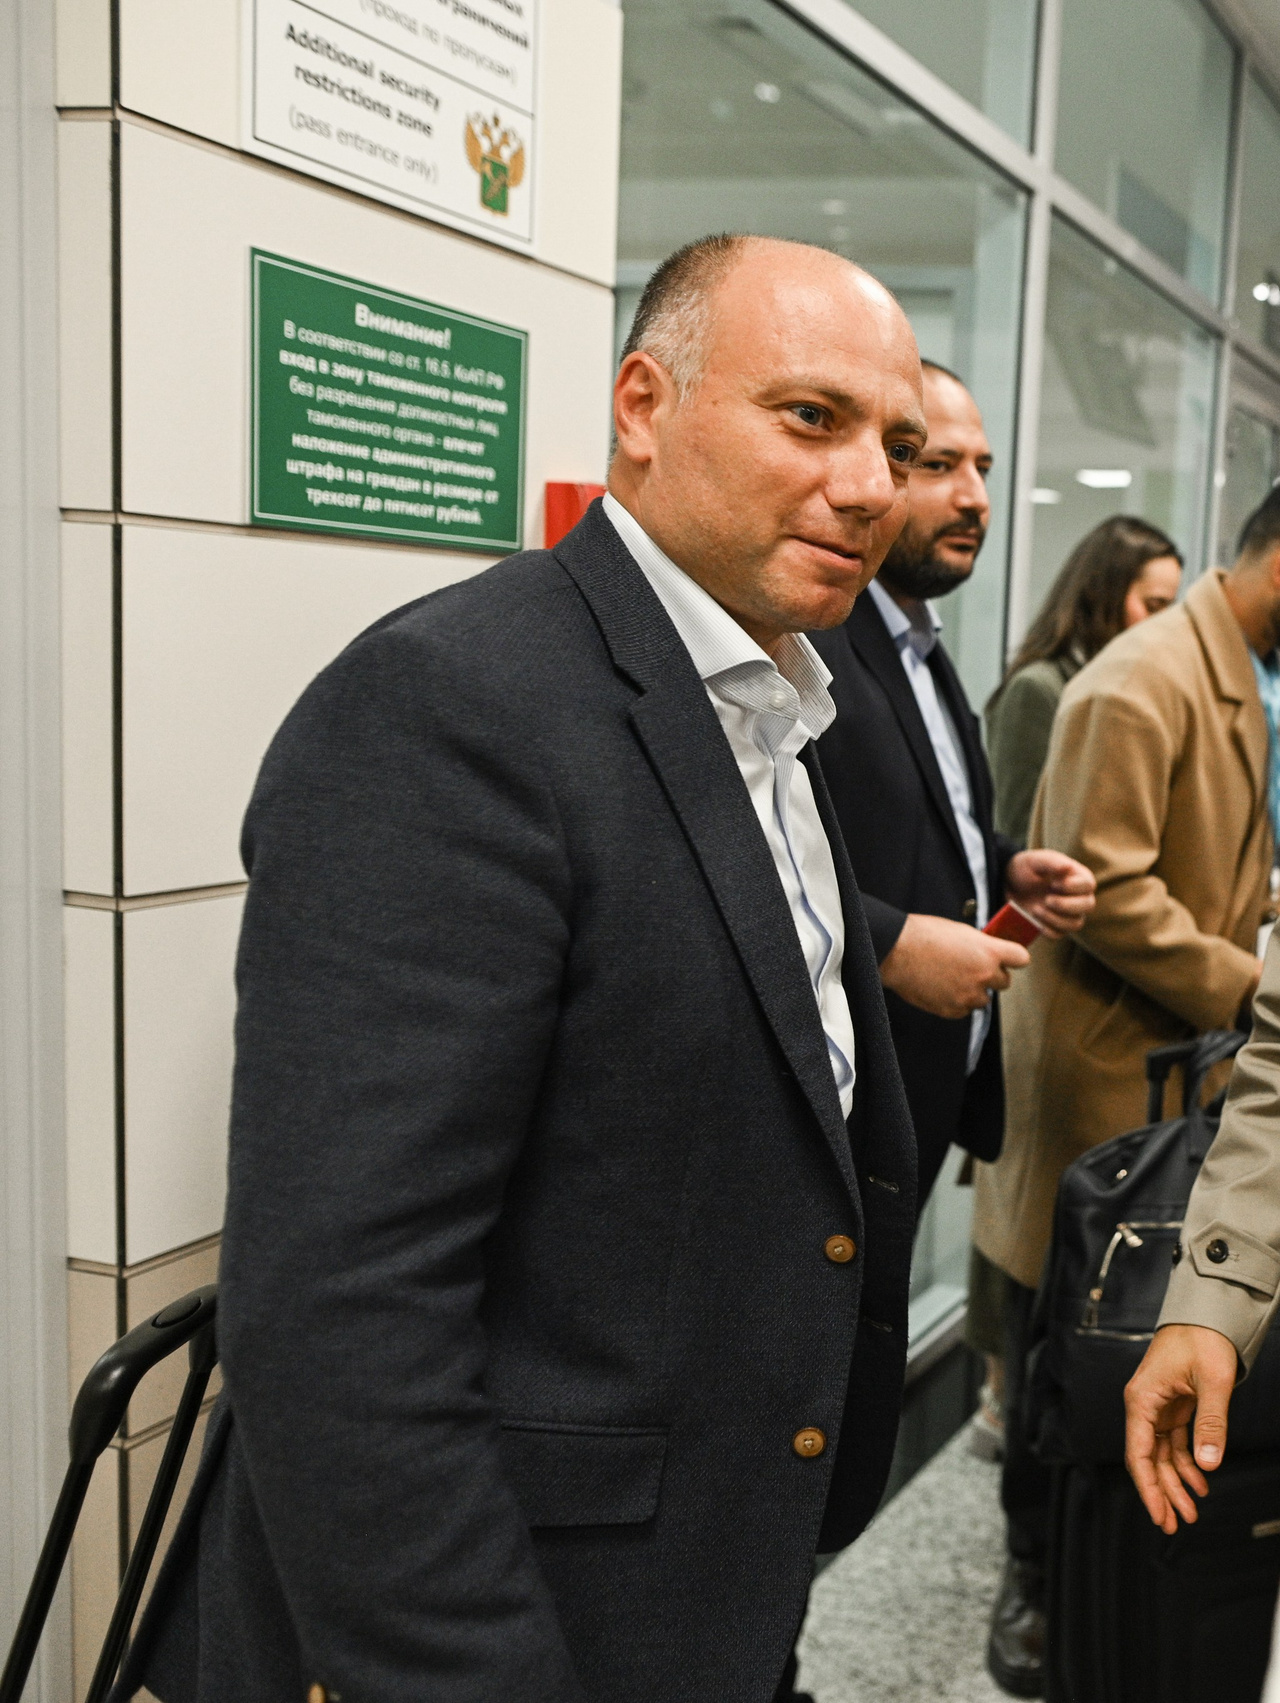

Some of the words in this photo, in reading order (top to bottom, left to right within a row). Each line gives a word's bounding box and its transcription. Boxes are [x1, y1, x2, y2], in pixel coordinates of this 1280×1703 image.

[421, 23, 440, 45] по
[285, 23, 374, 78] Additional
[379, 70, 441, 112] security
[295, 64, 392, 119] restrictions
[396, 110, 433, 138] zone
[289, 104, 332, 139] (pass
[335, 127, 400, 168] entrance
[403, 155, 440, 184] only)
[355, 302, 452, 350] Внимание!
[279, 349, 317, 374] вход
[318, 359, 330, 375] в
[331, 361, 365, 386] зону
[366, 369, 451, 403] таможенного
[451, 391, 509, 415] контроля
[283, 319, 296, 339] В
[297, 327, 387, 362] соответствии
[388, 350, 405, 368] со
[485, 371, 506, 391] РФ
[289, 375, 315, 398] без
[316, 385, 397, 415] разрешения
[397, 402, 475, 431] должностных
[475, 419, 500, 437] лиц
[306, 408, 392, 439] таможенного
[393, 426, 435, 448] органа
[443, 436, 486, 456] влечет
[286, 458, 345, 483] штрафа
[346, 468, 365, 485] на
[366, 471, 422, 493] граждан
[422, 480, 433, 495] в
[433, 482, 484, 503] размере
[484, 490, 500, 504] от
[291, 432, 371, 460] наложение
[371, 447, 497, 481] административного
[305, 487, 363, 507] трехсот
[363, 496, 384, 513] до
[383, 498, 436, 519] пятисот
